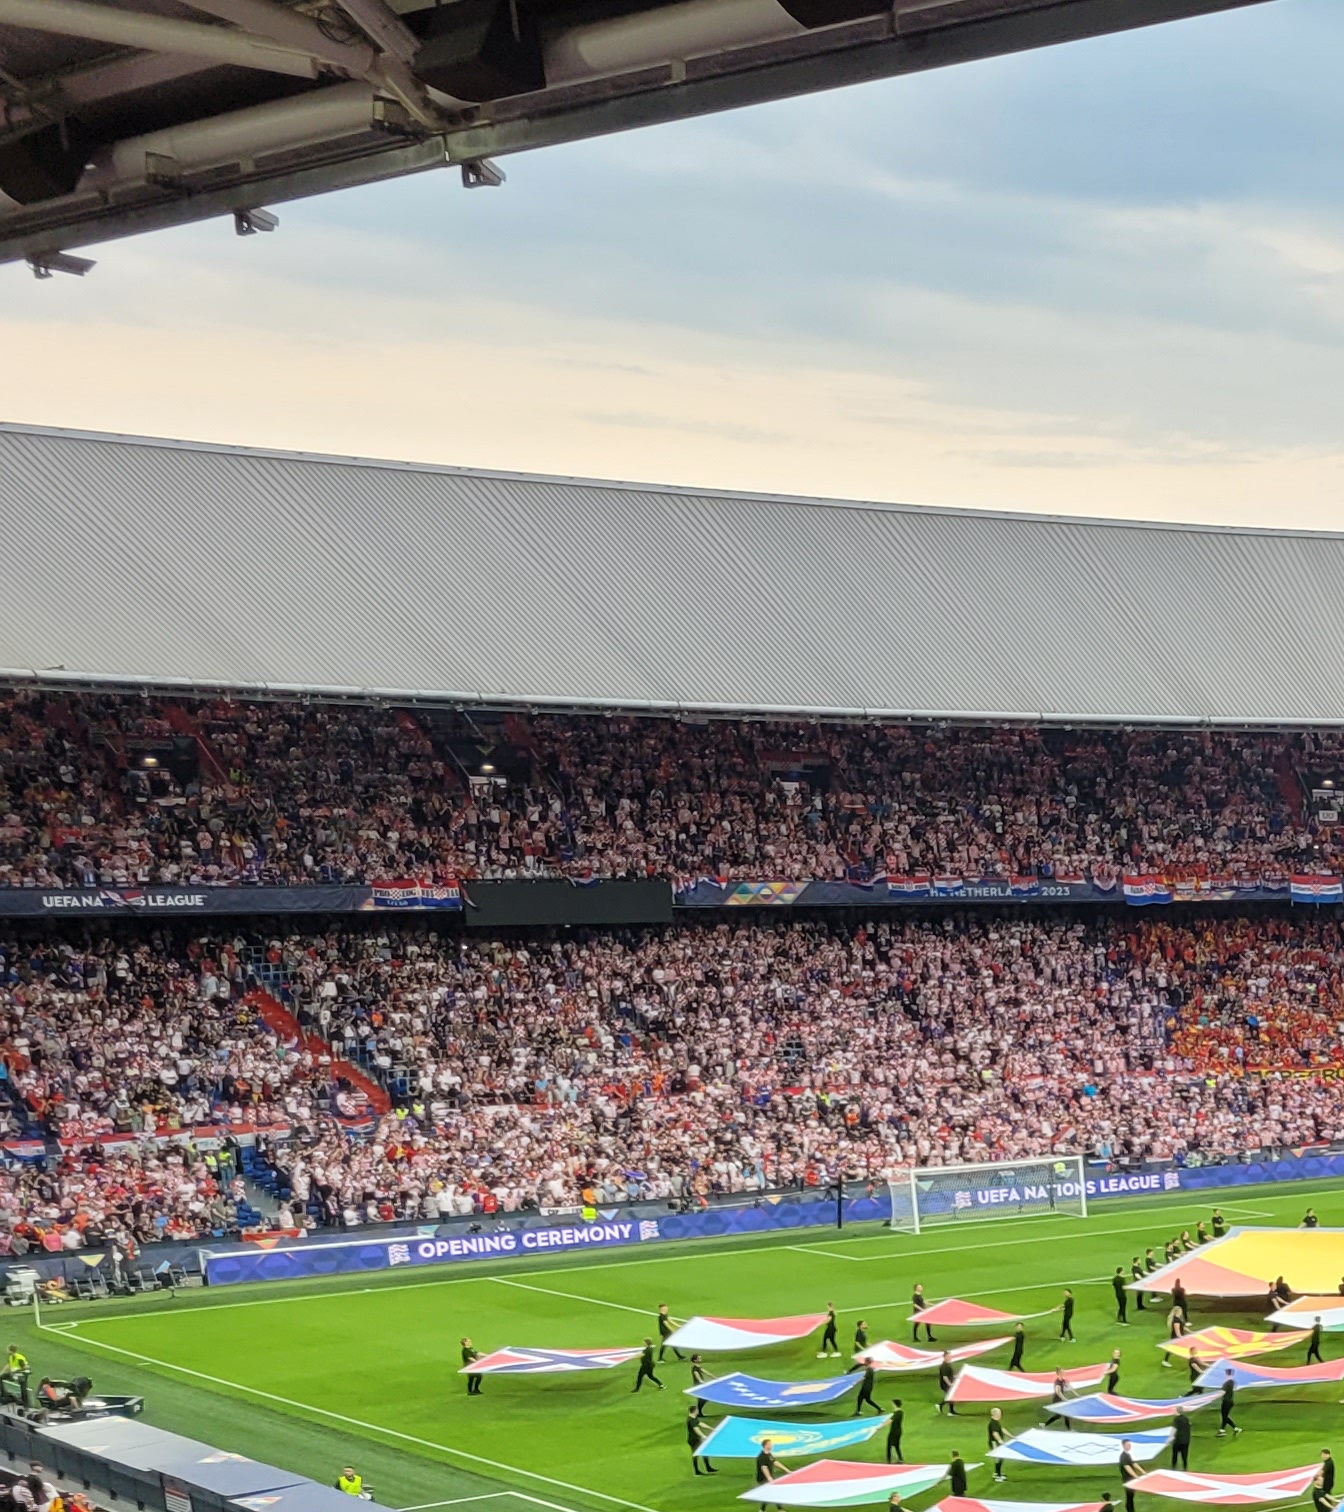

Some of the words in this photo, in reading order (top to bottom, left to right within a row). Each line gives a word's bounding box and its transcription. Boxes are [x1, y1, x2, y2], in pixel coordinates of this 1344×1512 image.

[1041, 886, 1071, 897] 2023
[42, 895, 82, 908] UEFA
[148, 894, 205, 908] LEAGUE
[976, 1190, 1020, 1205] UEFA
[1100, 1174, 1160, 1193] LEAGUE
[418, 1234, 517, 1260] OPENING
[521, 1223, 633, 1250] CEREMONY
